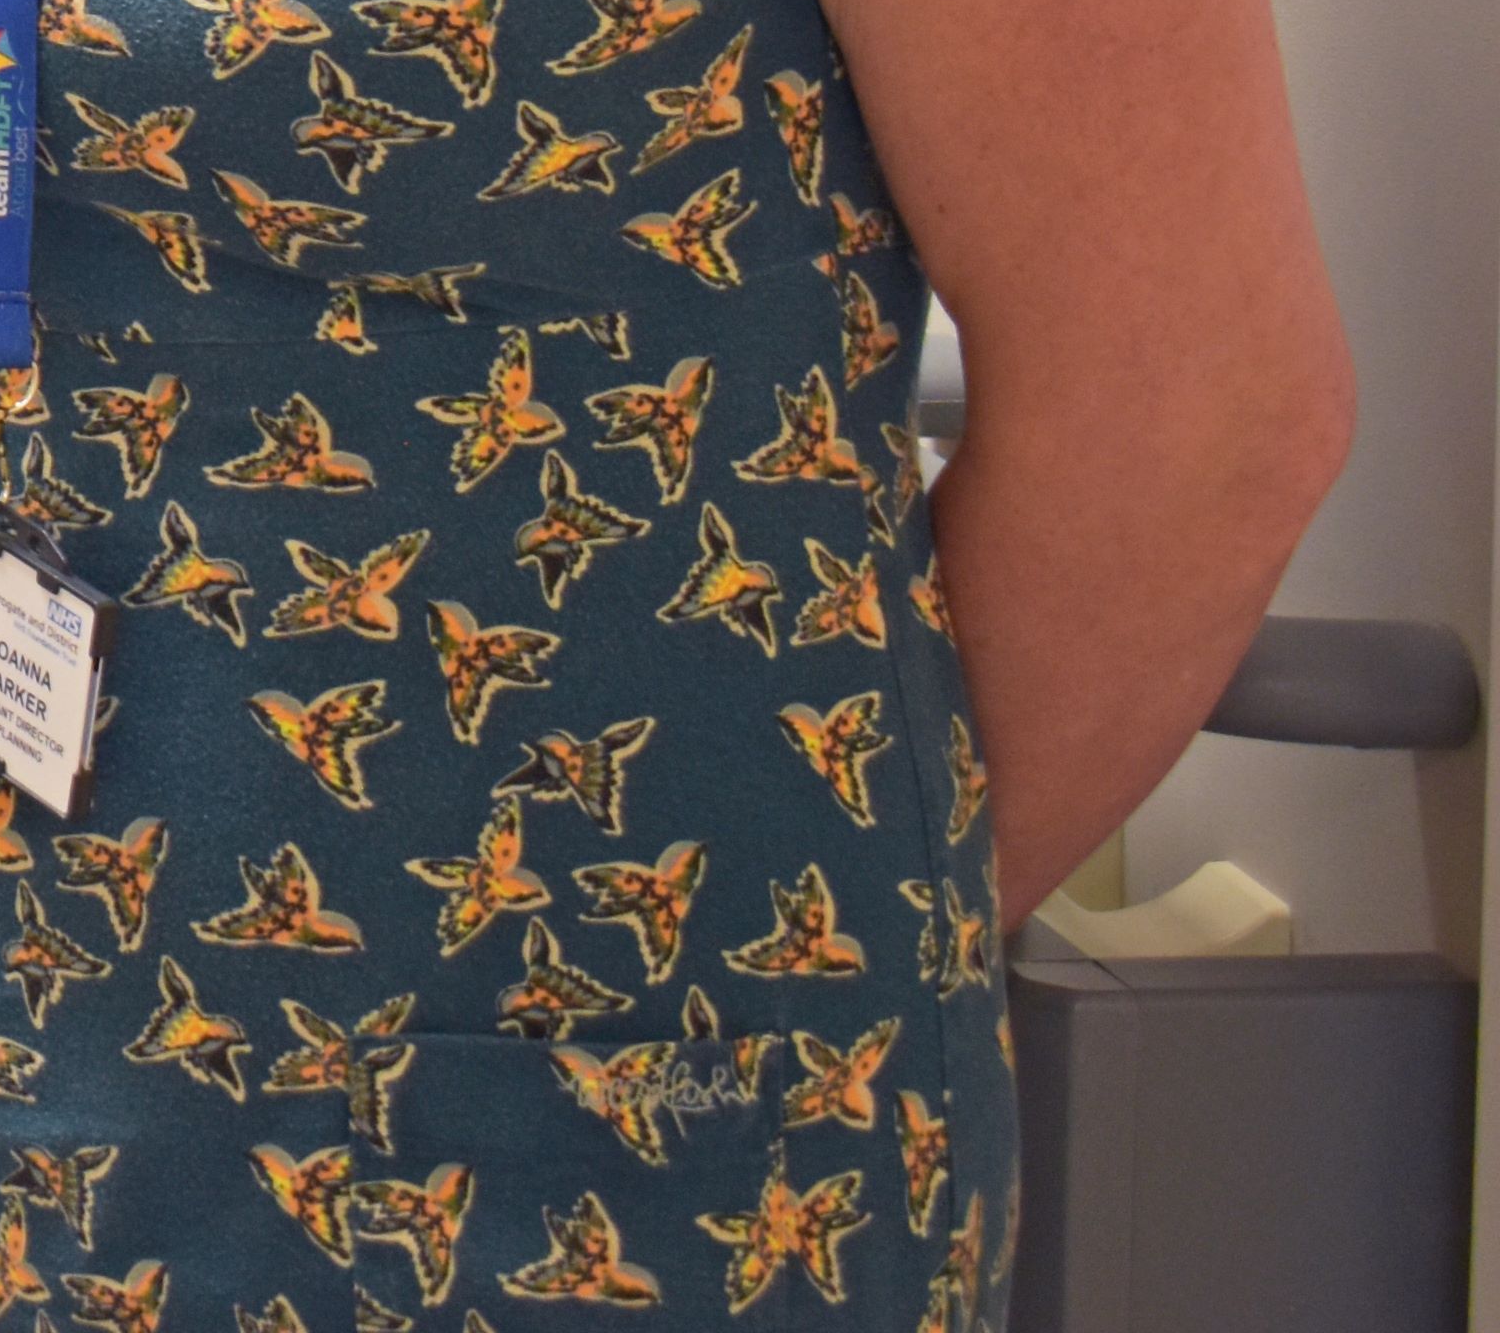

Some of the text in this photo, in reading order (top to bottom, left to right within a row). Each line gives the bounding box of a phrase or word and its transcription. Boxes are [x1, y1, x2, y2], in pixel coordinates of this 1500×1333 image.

[14, 126, 28, 162] best
[28, 613, 45, 633] and
[46, 623, 78, 653] District
[49, 600, 80, 636] NHS
[16, 716, 64, 757] DIRECTOR
